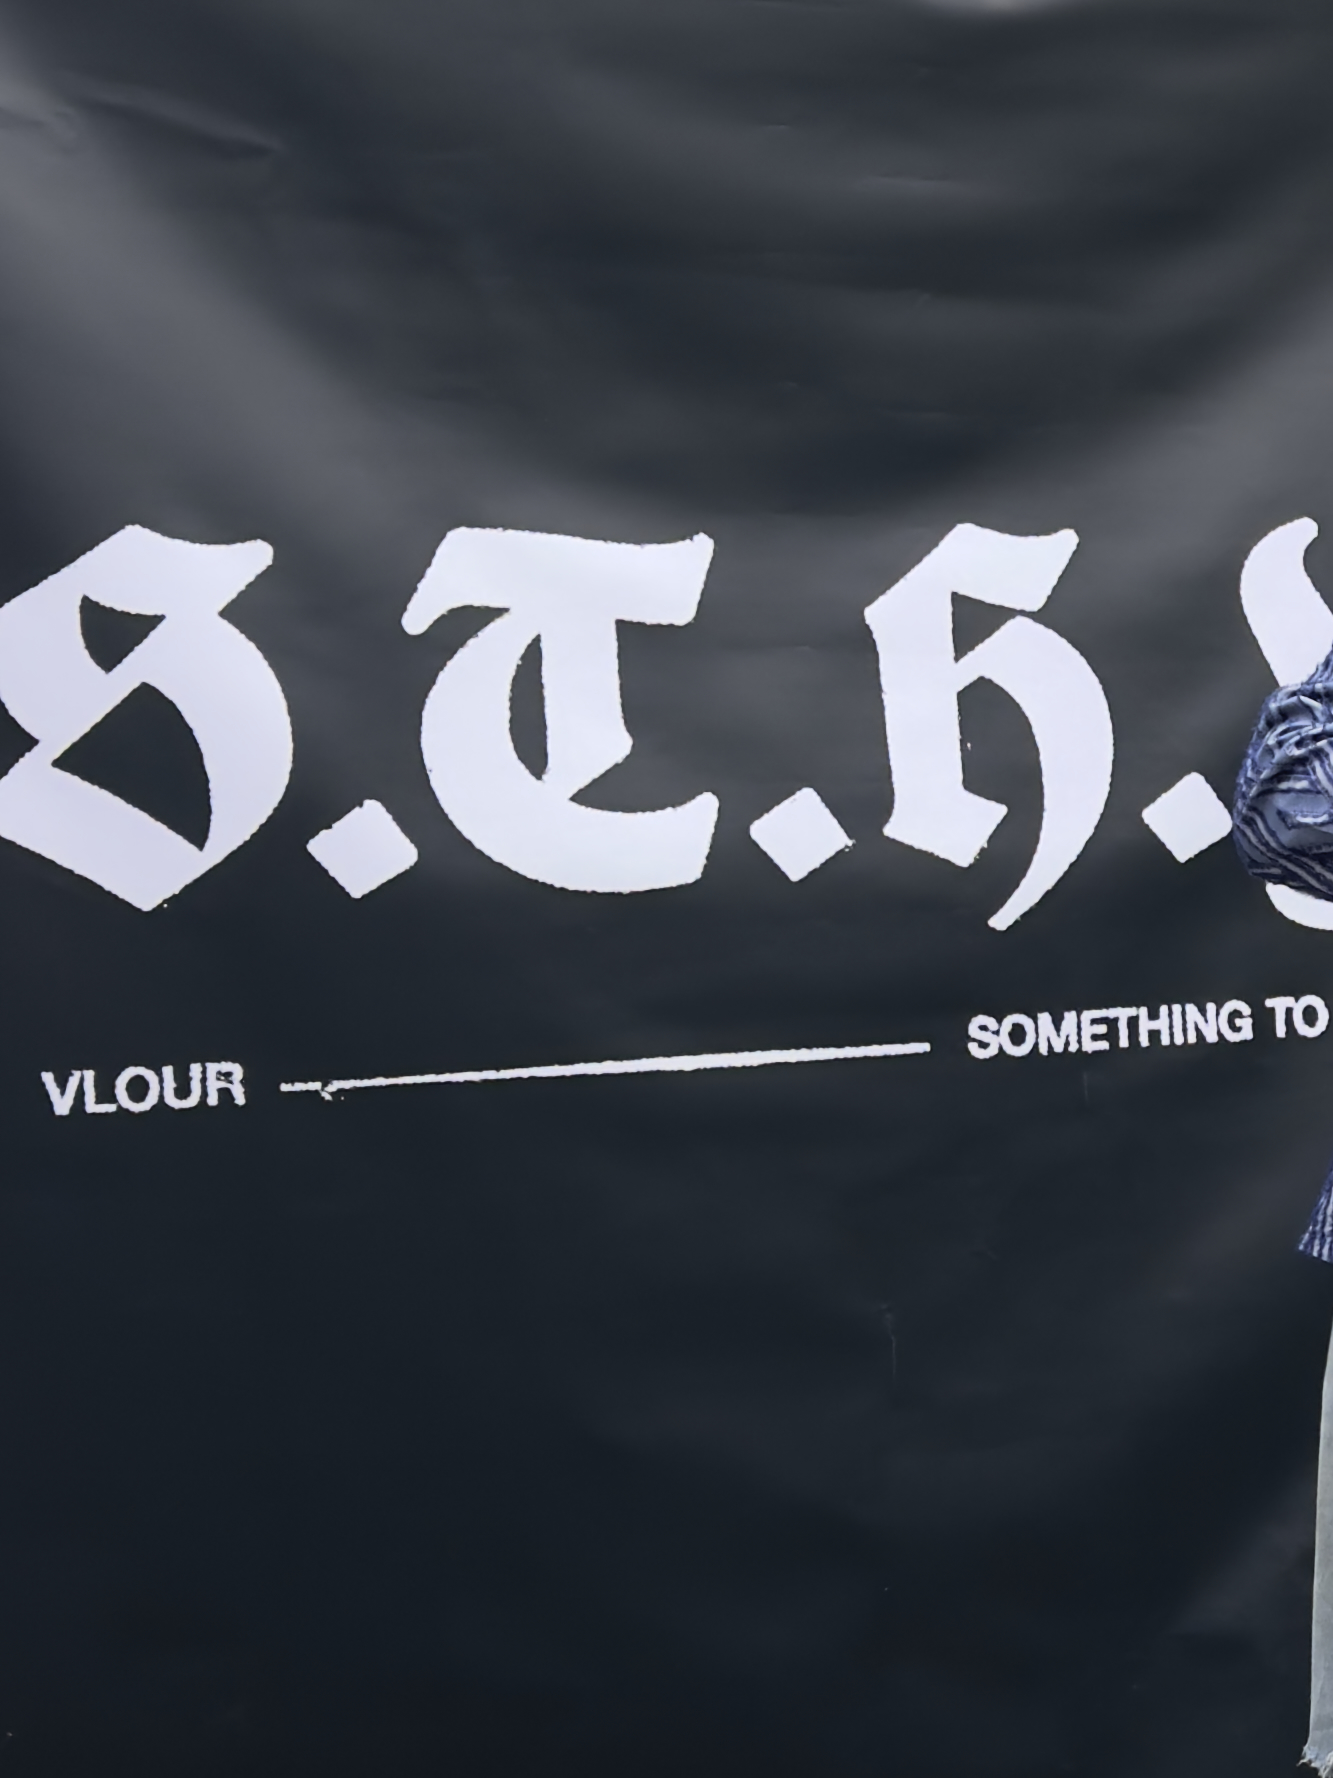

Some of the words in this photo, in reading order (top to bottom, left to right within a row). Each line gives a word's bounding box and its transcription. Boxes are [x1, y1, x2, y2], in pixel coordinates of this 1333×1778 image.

[41, 1061, 246, 1116] VLOUR
[967, 998, 1254, 1060] SOMETHING
[1265, 994, 1330, 1038] TO
